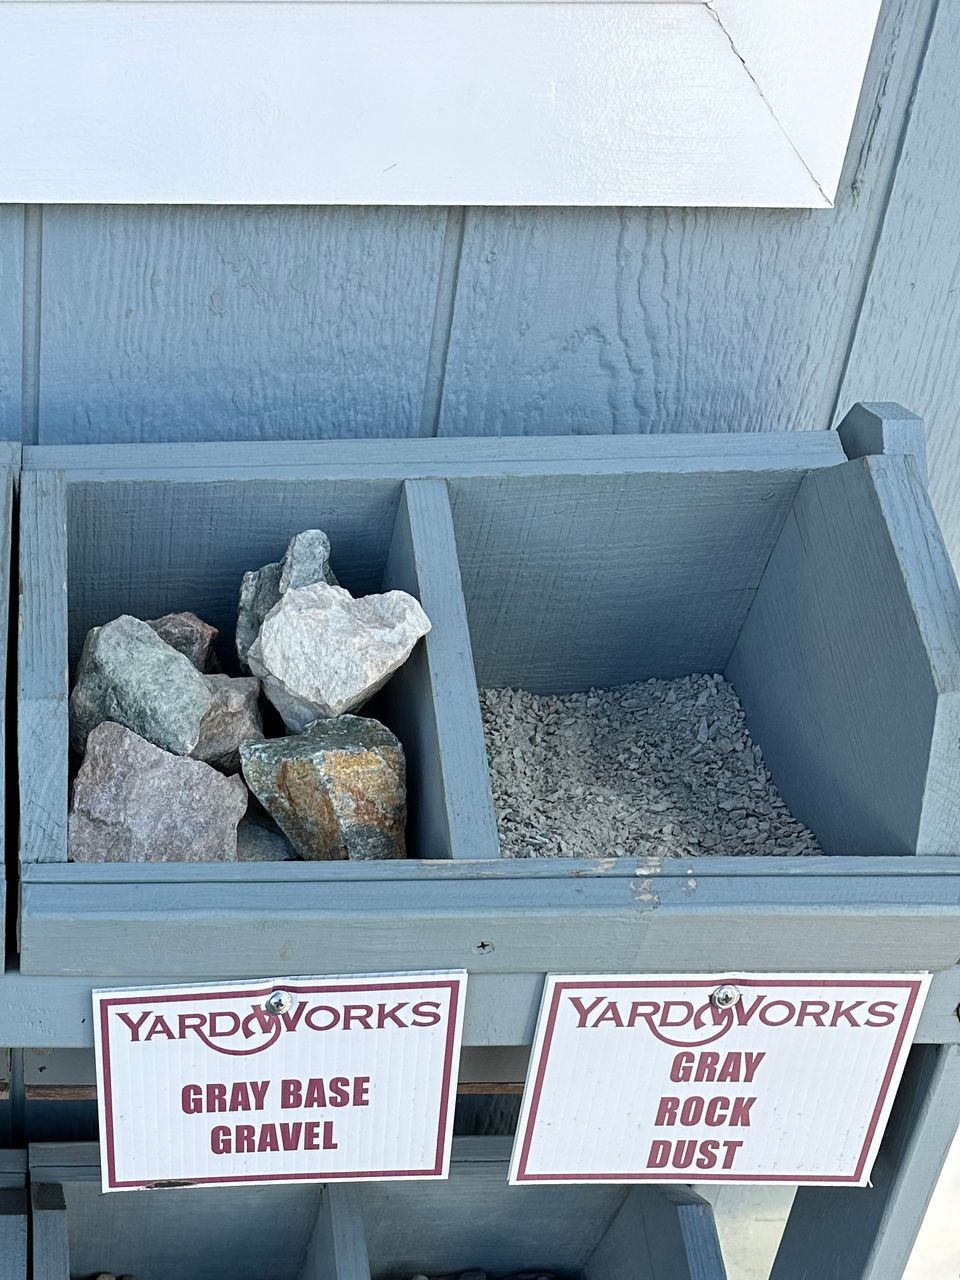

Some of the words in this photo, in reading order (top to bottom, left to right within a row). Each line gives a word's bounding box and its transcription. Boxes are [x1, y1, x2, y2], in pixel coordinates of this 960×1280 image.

[670, 1052, 765, 1082] GRAY
[181, 1081, 271, 1115] GRAY
[281, 1077, 369, 1108] BASE
[655, 1096, 756, 1126] ROCK
[211, 1121, 337, 1154] GRAVEL
[647, 1140, 743, 1169] DUST
